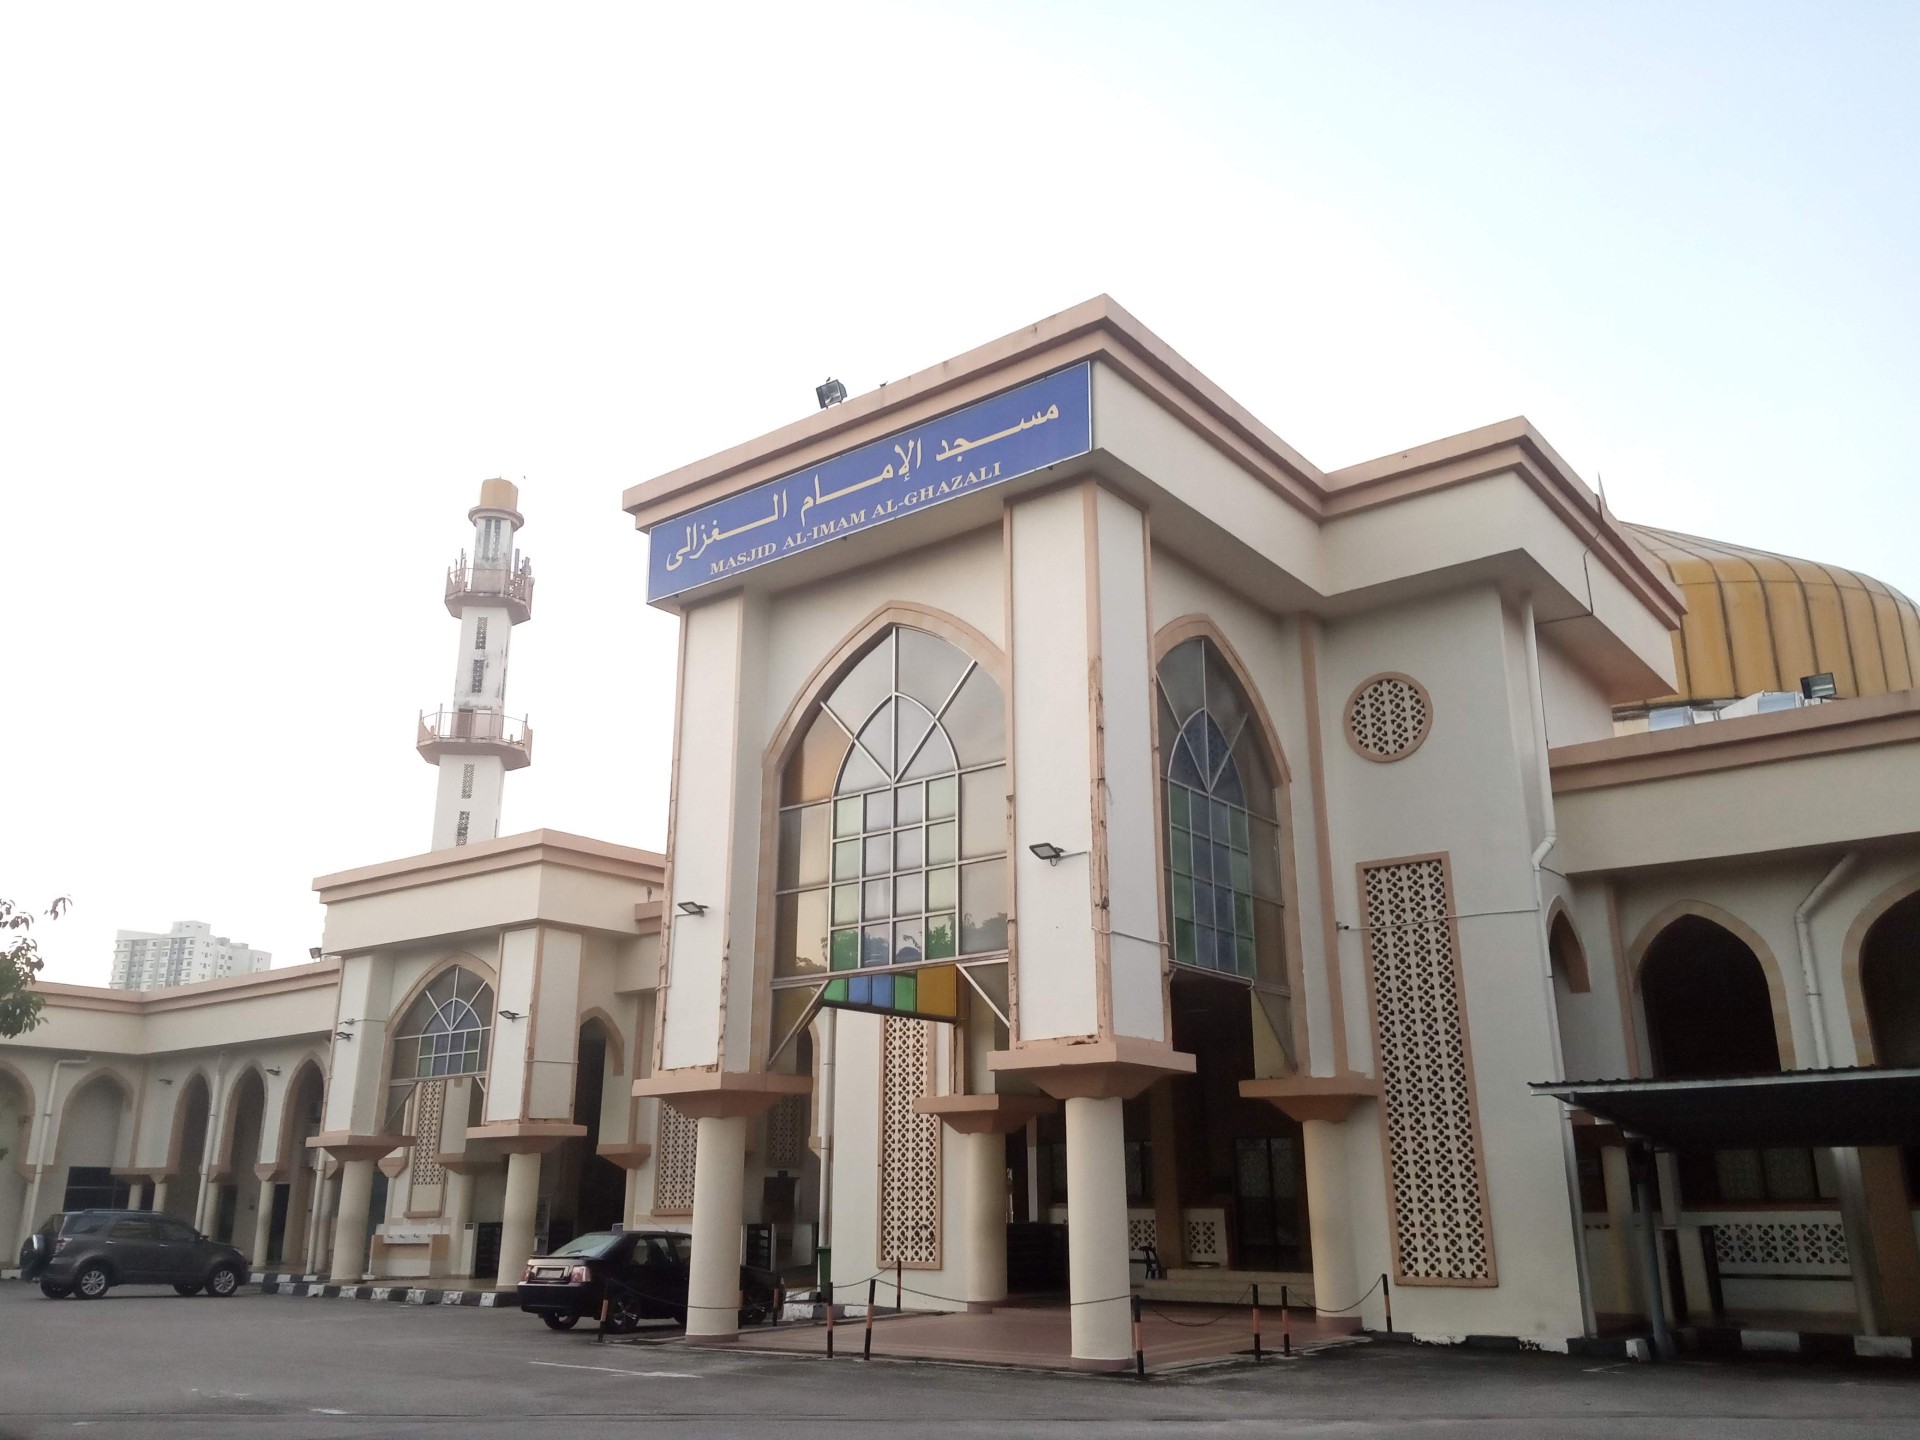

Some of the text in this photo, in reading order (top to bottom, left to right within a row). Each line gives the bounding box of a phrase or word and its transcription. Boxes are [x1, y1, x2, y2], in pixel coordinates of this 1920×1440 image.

[935, 403, 1060, 463] مسجد
[709, 461, 1002, 575] MASJID AL-IMAM AL-GHAZALI
